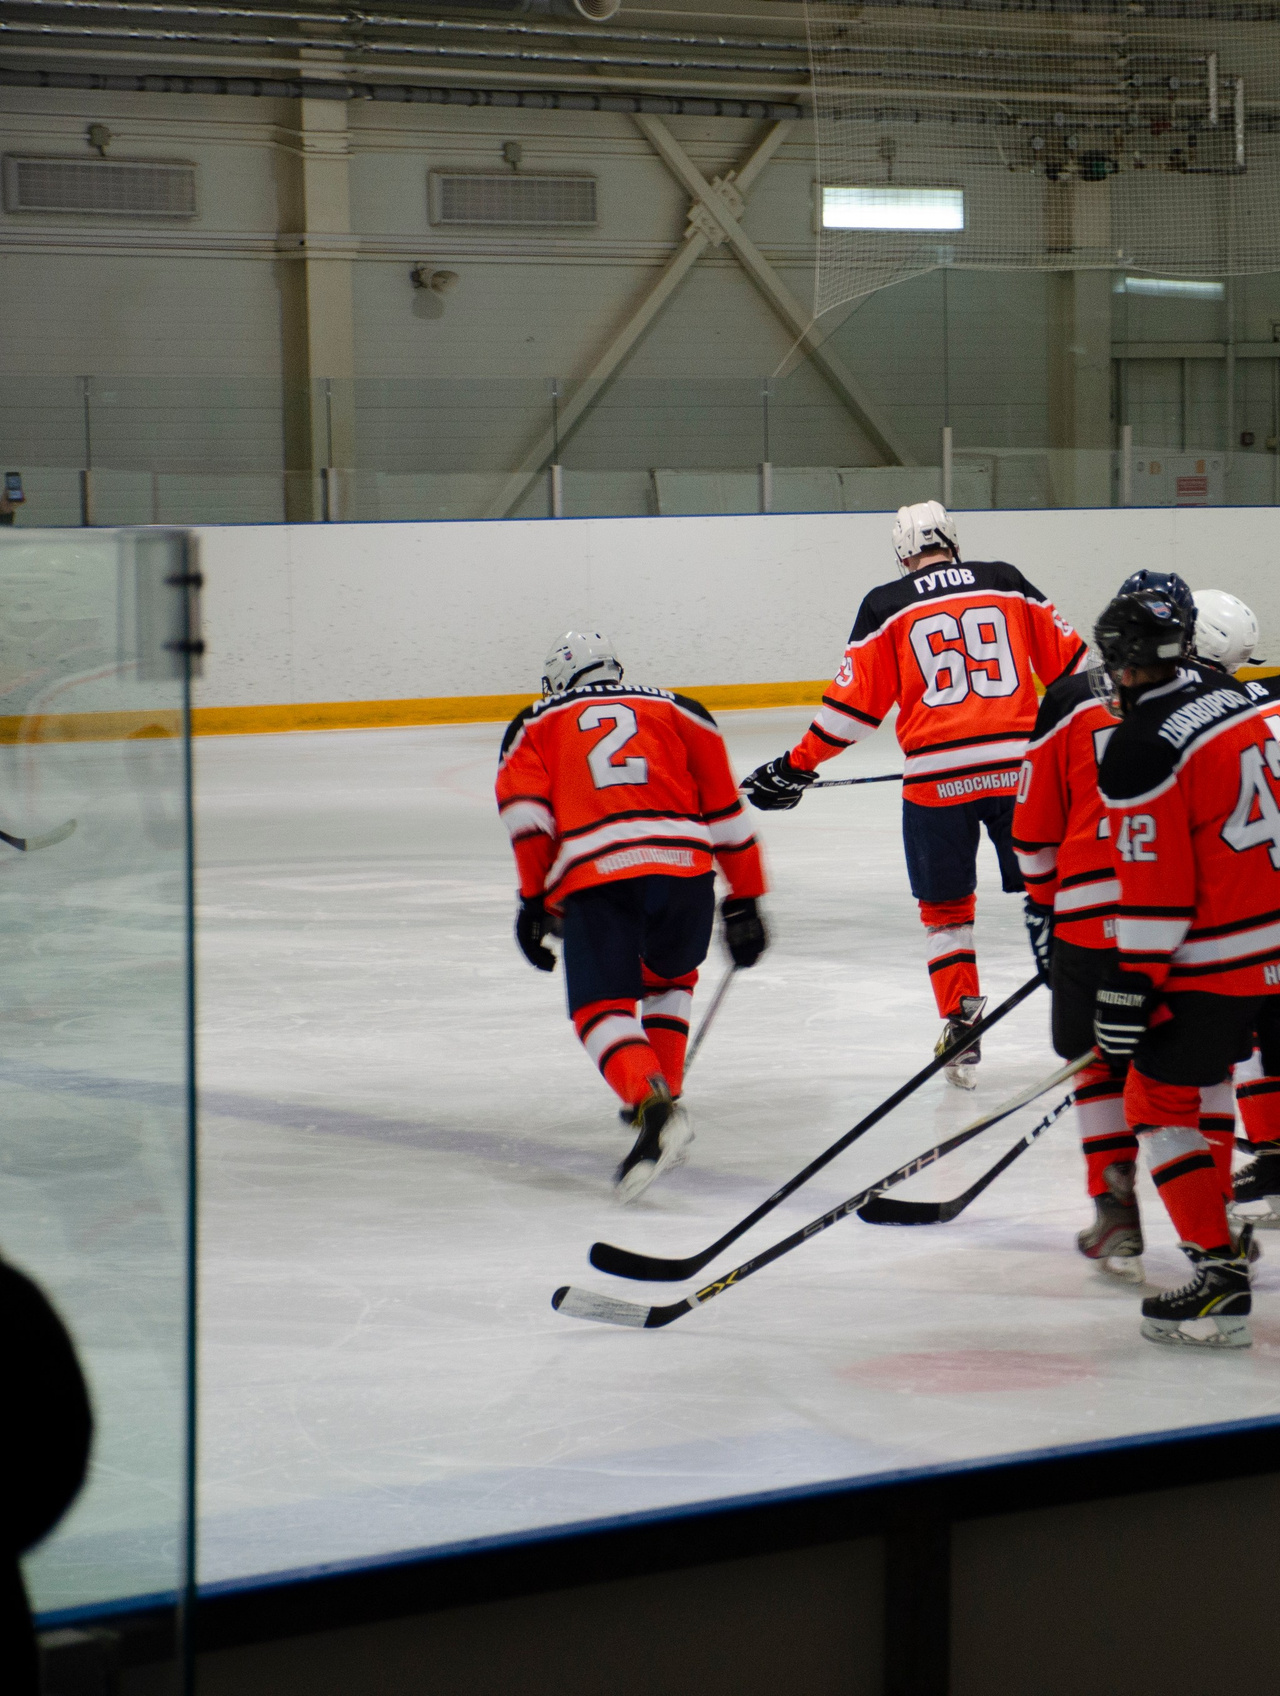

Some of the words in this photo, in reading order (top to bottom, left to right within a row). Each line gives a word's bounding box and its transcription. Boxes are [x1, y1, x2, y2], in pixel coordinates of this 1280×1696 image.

[913, 568, 975, 594] ГУТОВ
[835, 656, 853, 687] 9
[909, 605, 1020, 708] 69
[576, 702, 648, 790] 2
[766, 763, 805, 791] CCM
[936, 771, 1020, 799] НОВОСИБИР
[1115, 814, 1158, 863] 42
[803, 1148, 939, 1237] STEALTH
